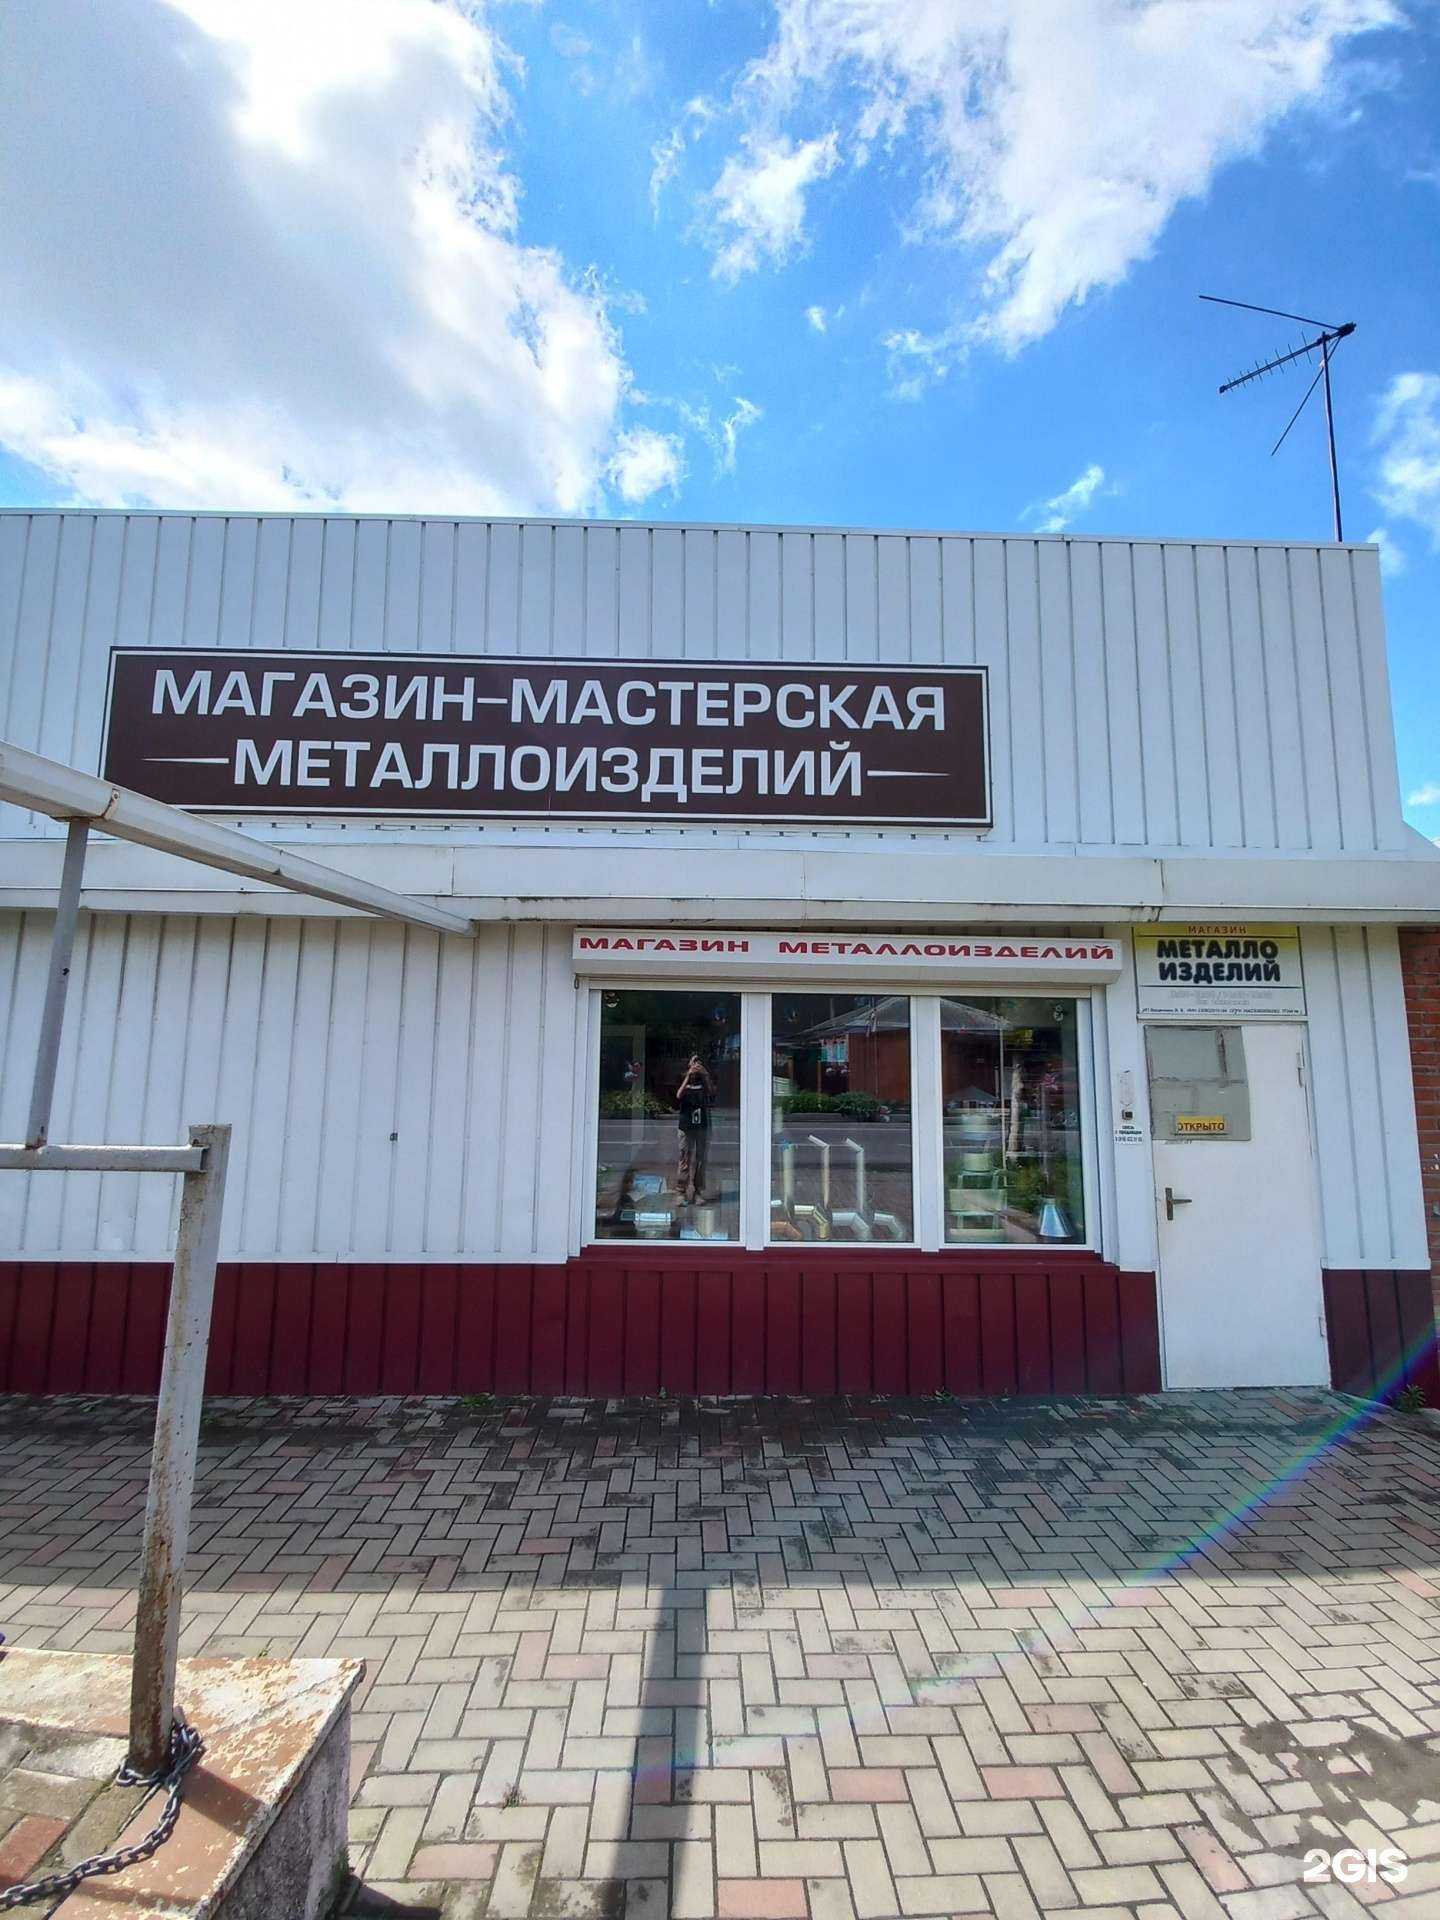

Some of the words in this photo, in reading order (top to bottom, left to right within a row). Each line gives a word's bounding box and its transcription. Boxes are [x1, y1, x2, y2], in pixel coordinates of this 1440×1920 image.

[150, 669, 947, 733] МАГАЗИН-МАСТЕРСКАЯ
[233, 738, 864, 804] МЕТАЛЛОИЗДЕЛИЙ
[1187, 925, 1248, 935] МАГАЗИН
[579, 937, 750, 953] МАГАЗИН
[778, 940, 1114, 960] МЕТАЛЛОИЗДЕЛИЙ
[1156, 939, 1279, 960] МЕТАЛЛО
[1157, 959, 1282, 985] ИЗДЕЛИЙ
